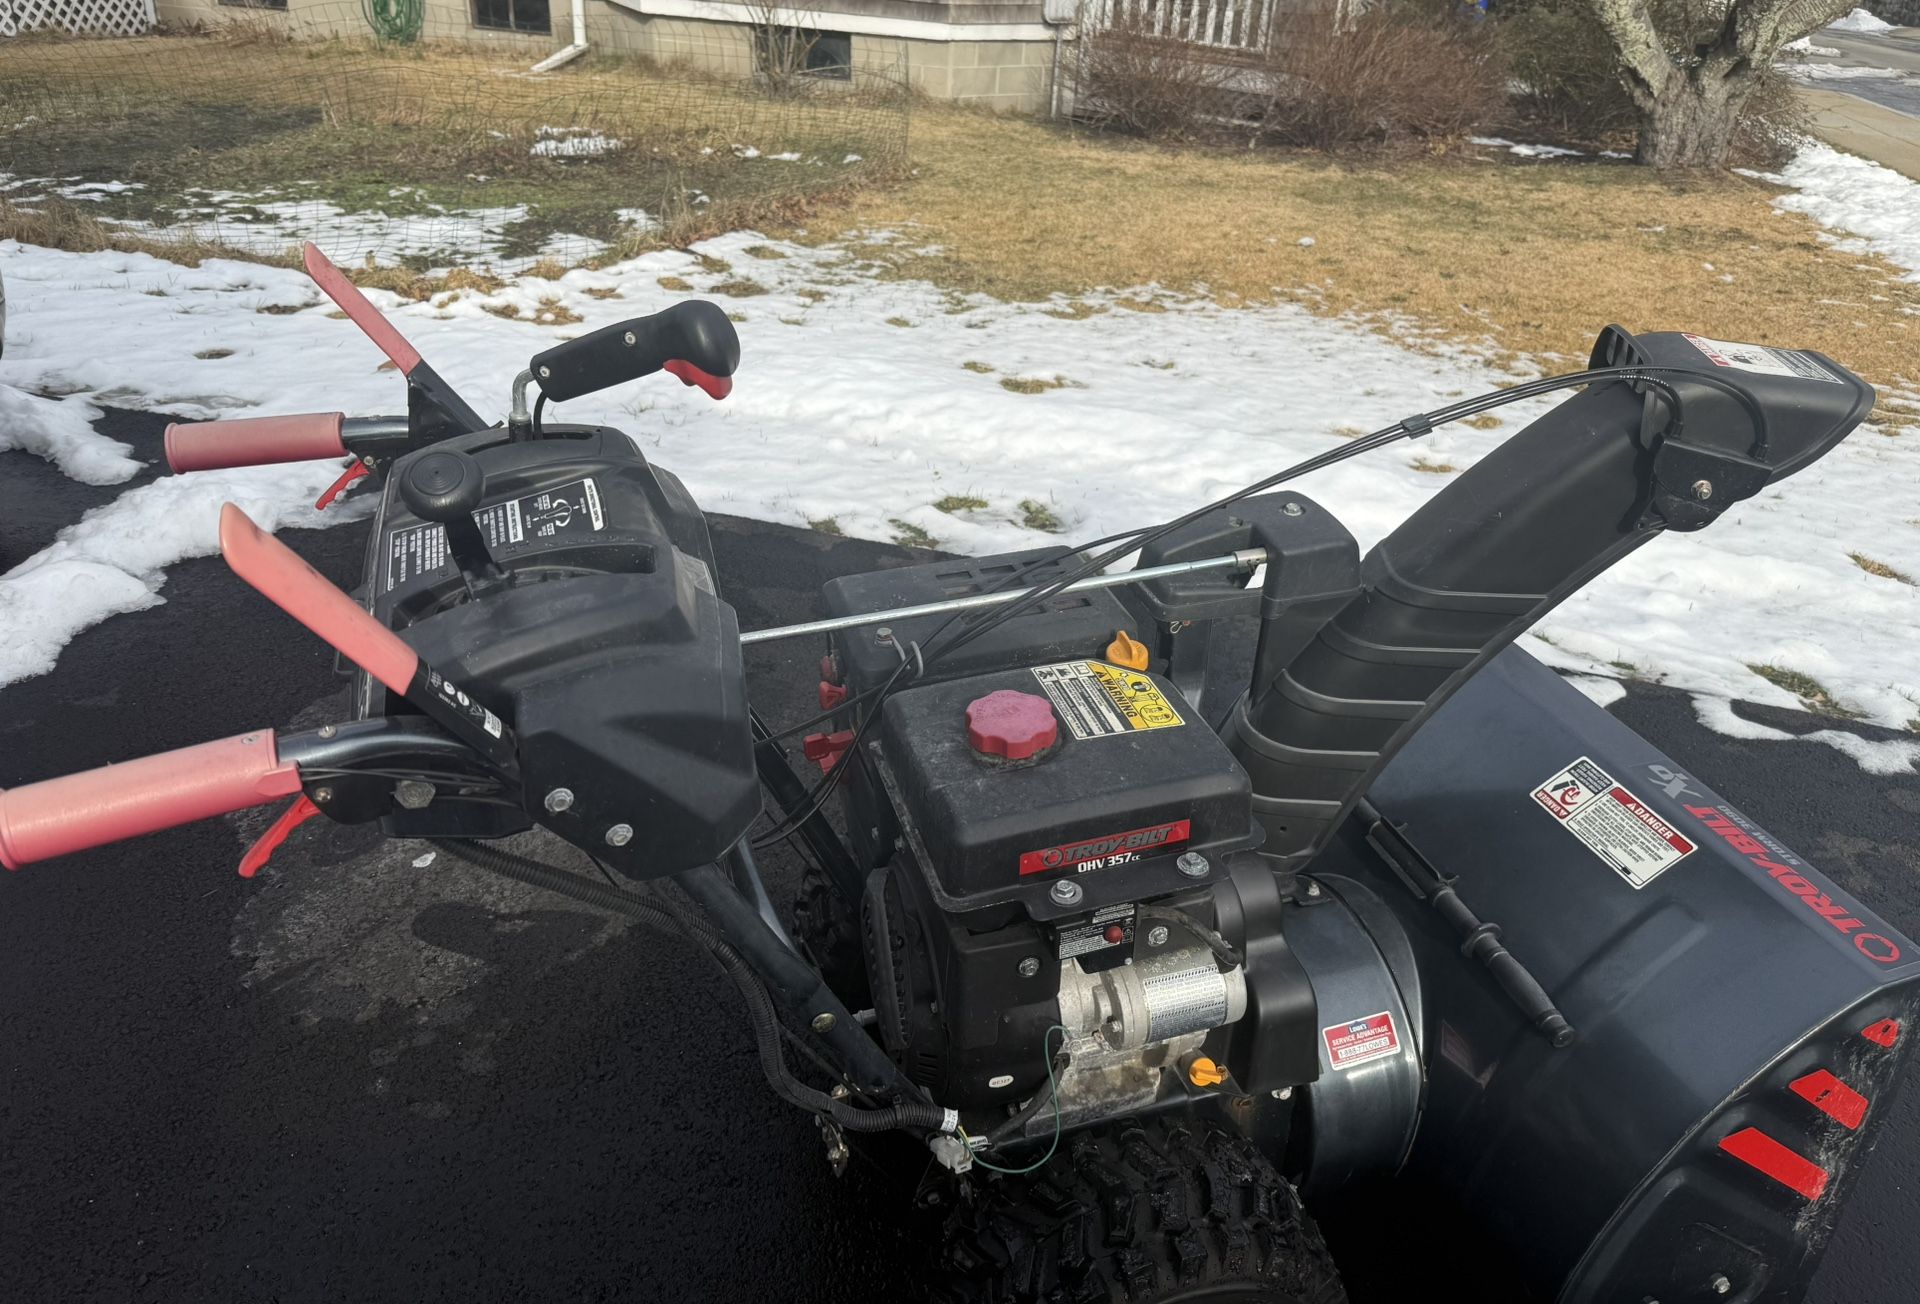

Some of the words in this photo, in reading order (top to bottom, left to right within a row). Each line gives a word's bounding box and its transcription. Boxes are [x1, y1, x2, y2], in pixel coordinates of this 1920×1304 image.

[1102, 679, 1138, 718] WARNING
[1535, 791, 1561, 814] DANGER
[1633, 807, 1674, 840] DANGER
[1064, 826, 1173, 863] TROY-BILT
[1755, 830, 1801, 866] STORM
[1077, 861, 1105, 873] OHV
[1683, 804, 1866, 934] TROY-BILT
[1331, 1033, 1356, 1046] SERVICE
[1356, 1025, 1389, 1040] ADVANTAGE
